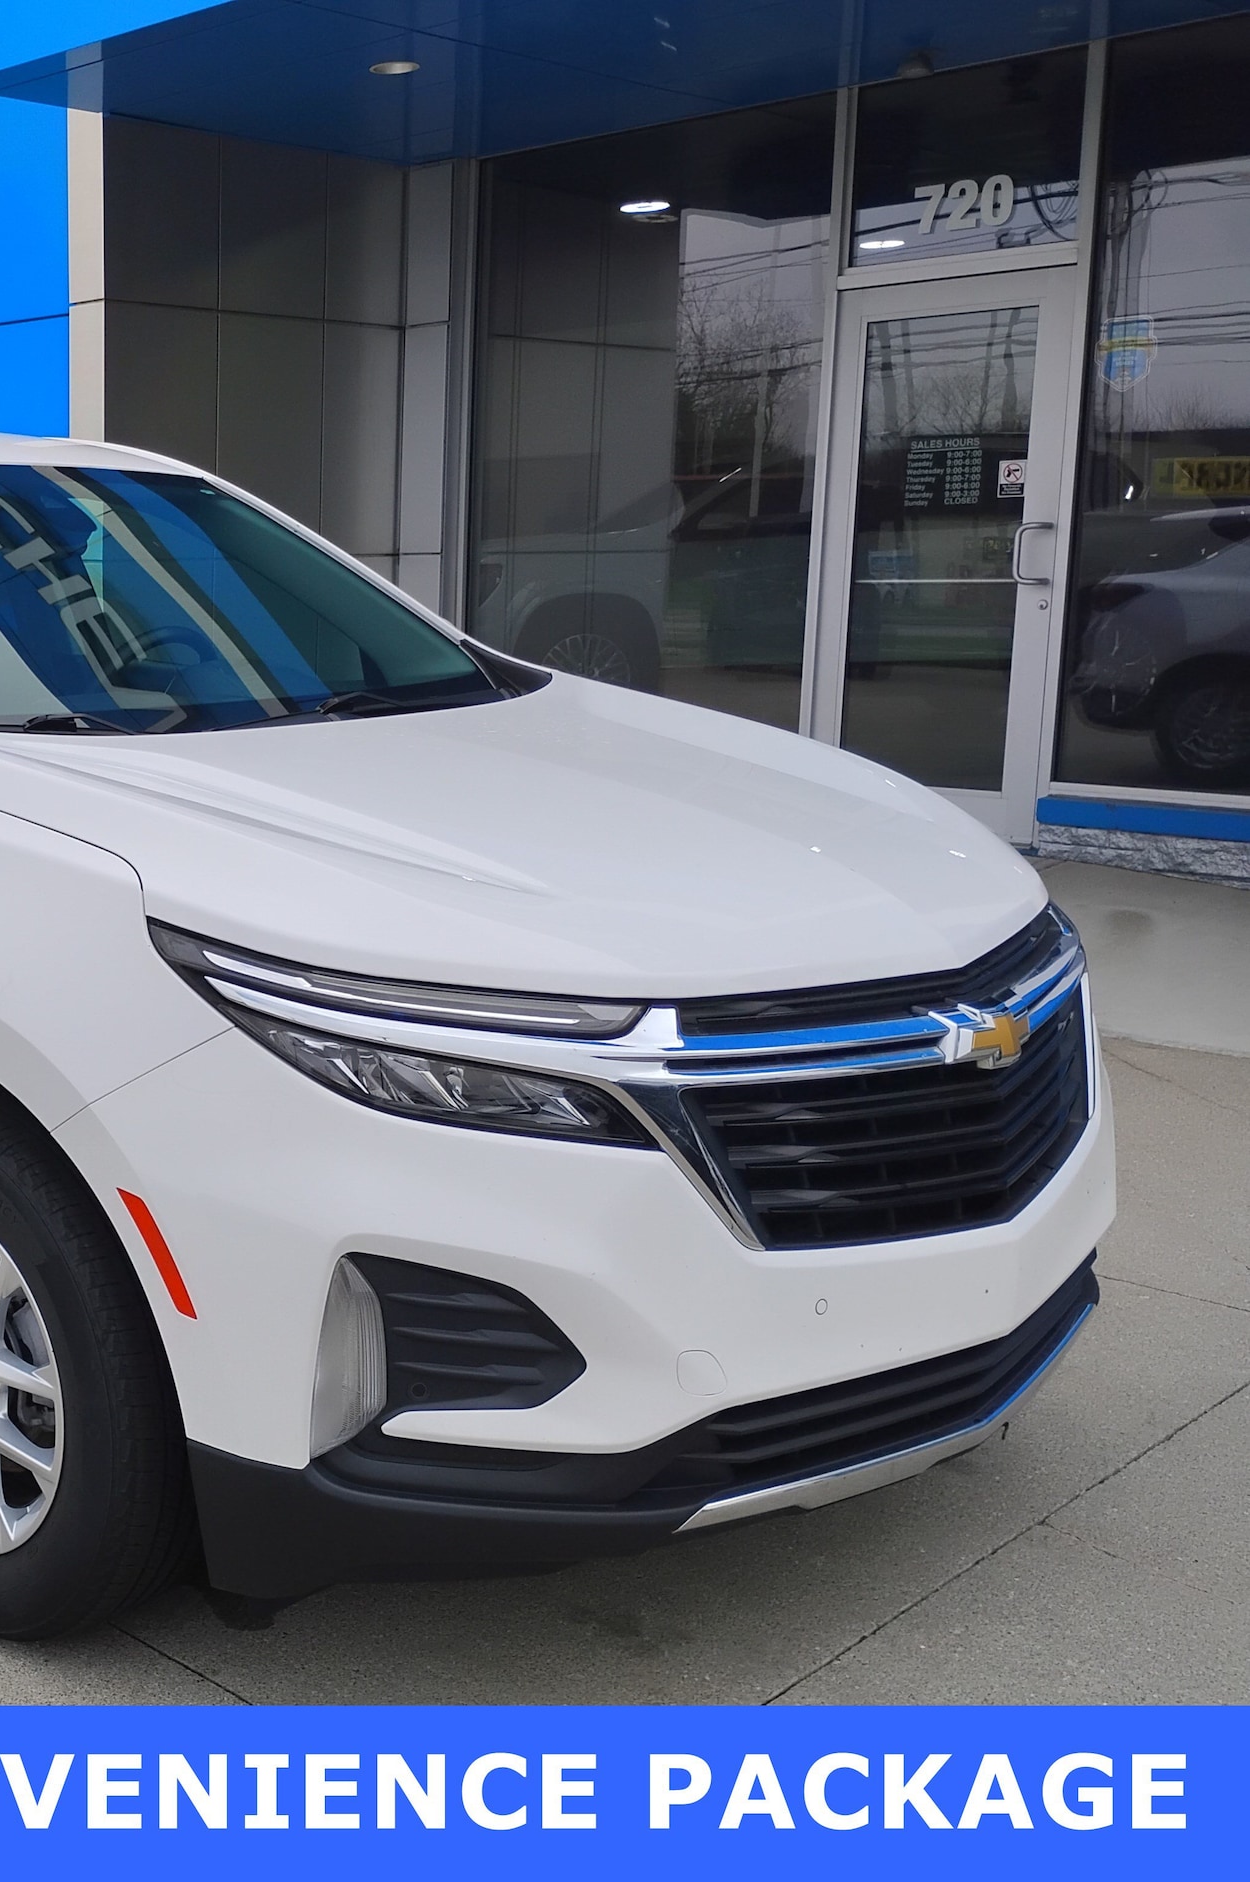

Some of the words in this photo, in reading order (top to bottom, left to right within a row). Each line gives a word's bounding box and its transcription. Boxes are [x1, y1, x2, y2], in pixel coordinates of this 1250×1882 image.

[914, 174, 1014, 235] 720
[911, 439, 943, 450] SALES
[945, 437, 980, 447] HOURS
[944, 497, 978, 505] CLOSED
